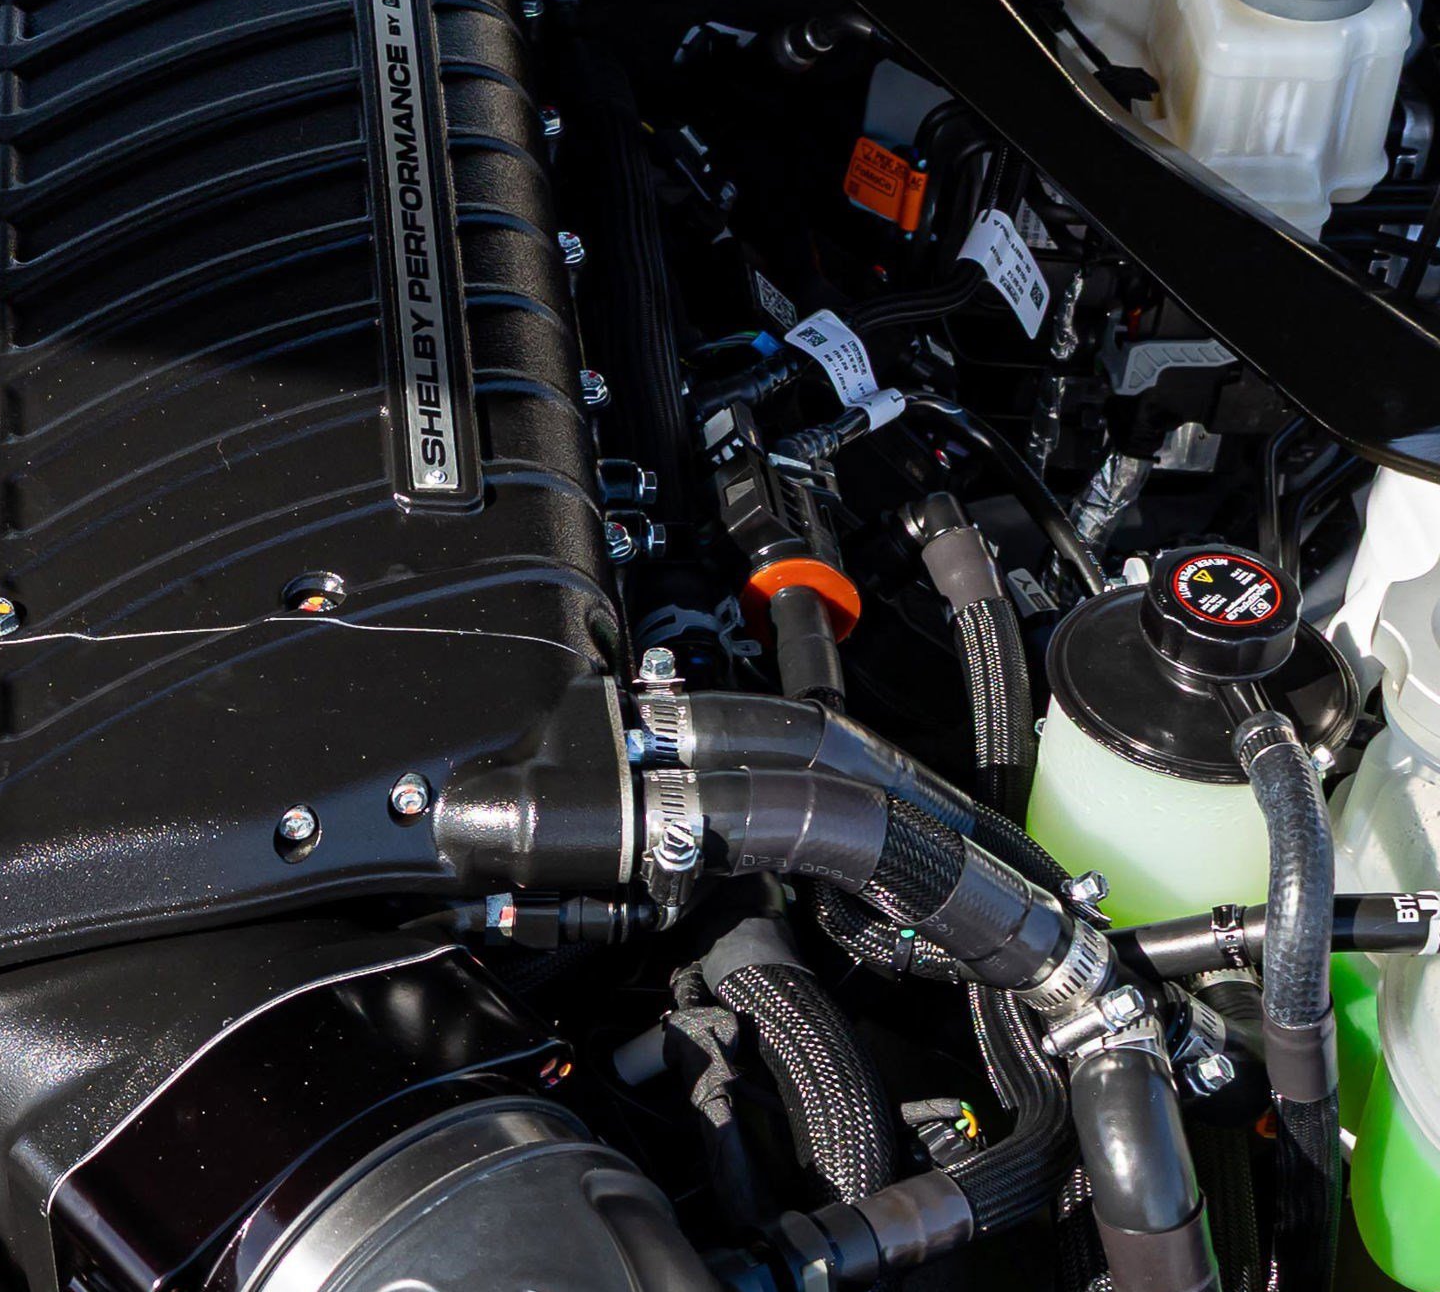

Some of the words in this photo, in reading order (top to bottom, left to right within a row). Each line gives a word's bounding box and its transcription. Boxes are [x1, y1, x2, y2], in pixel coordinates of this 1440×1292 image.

[387, 14, 401, 35] BY
[385, 42, 432, 303] PERFORMANCE
[408, 309, 447, 467] SHELBY
[1194, 558, 1228, 567] NEVER
